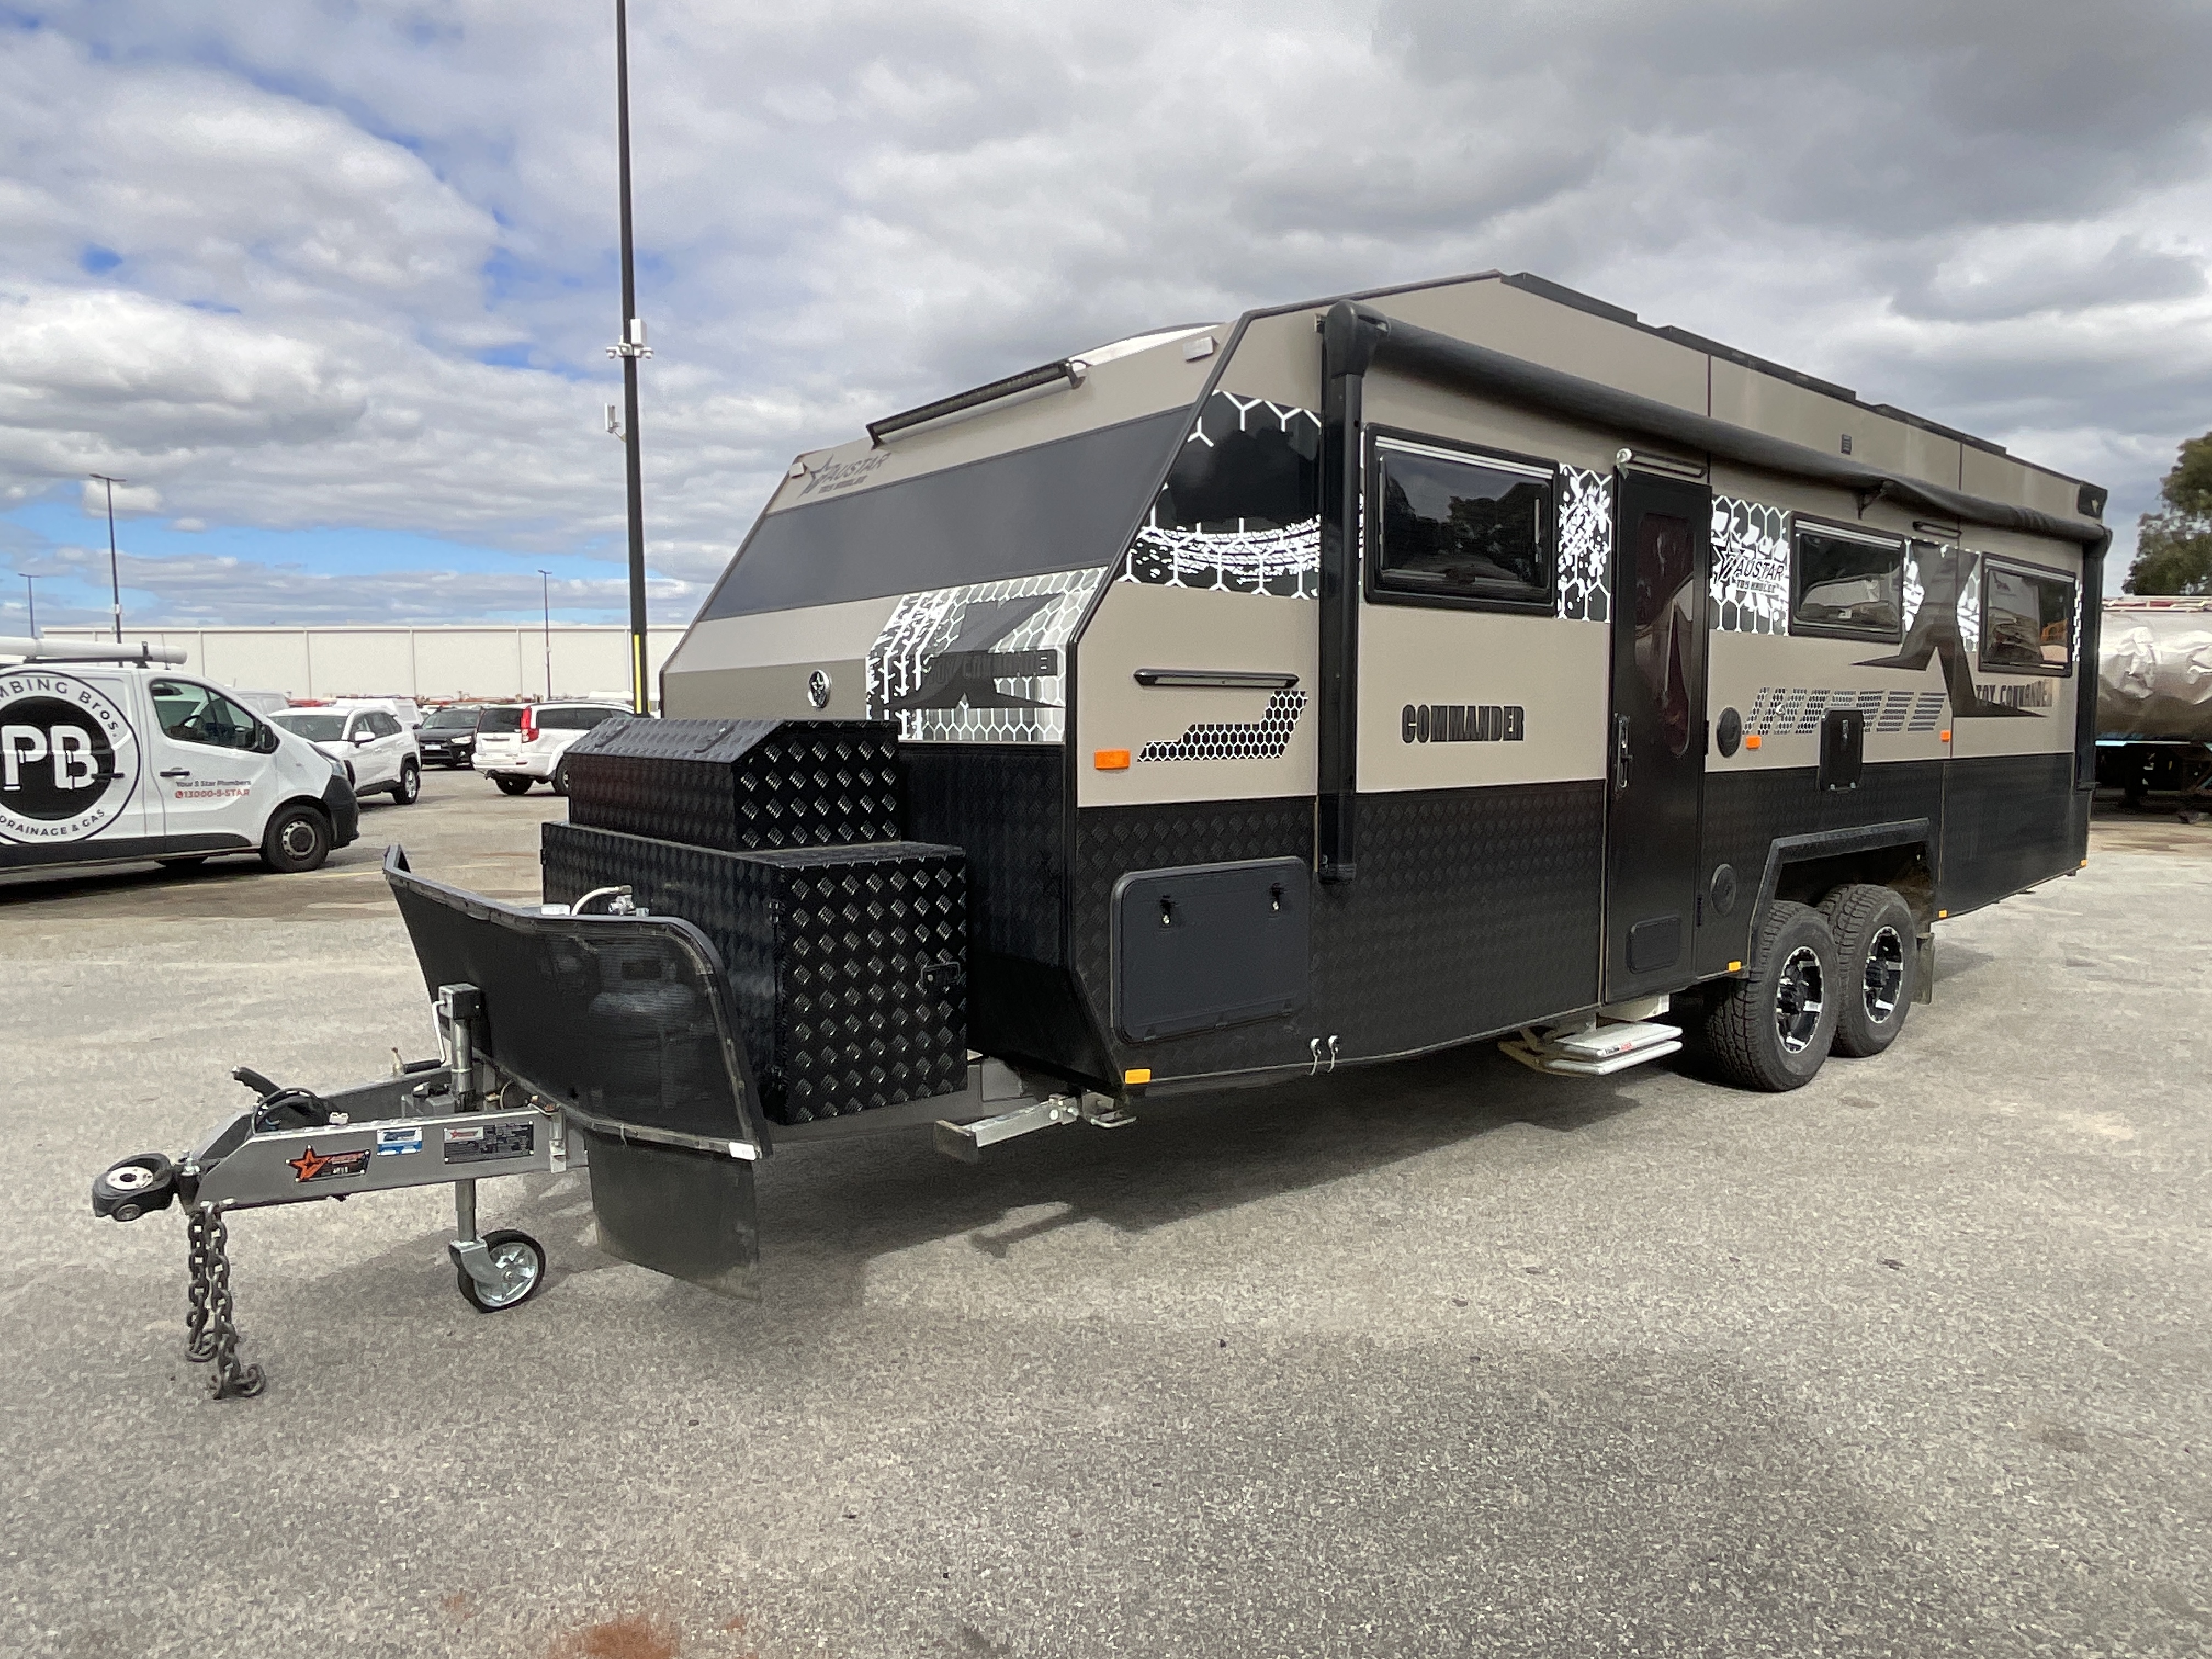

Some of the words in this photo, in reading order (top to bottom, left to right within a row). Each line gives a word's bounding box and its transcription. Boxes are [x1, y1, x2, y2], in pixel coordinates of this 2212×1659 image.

[1734, 559, 1784, 582] AUSTAR
[1402, 704, 1524, 743] COMMANDER
[1, 725, 99, 791] PB
[82, 809, 105, 827] GAS
